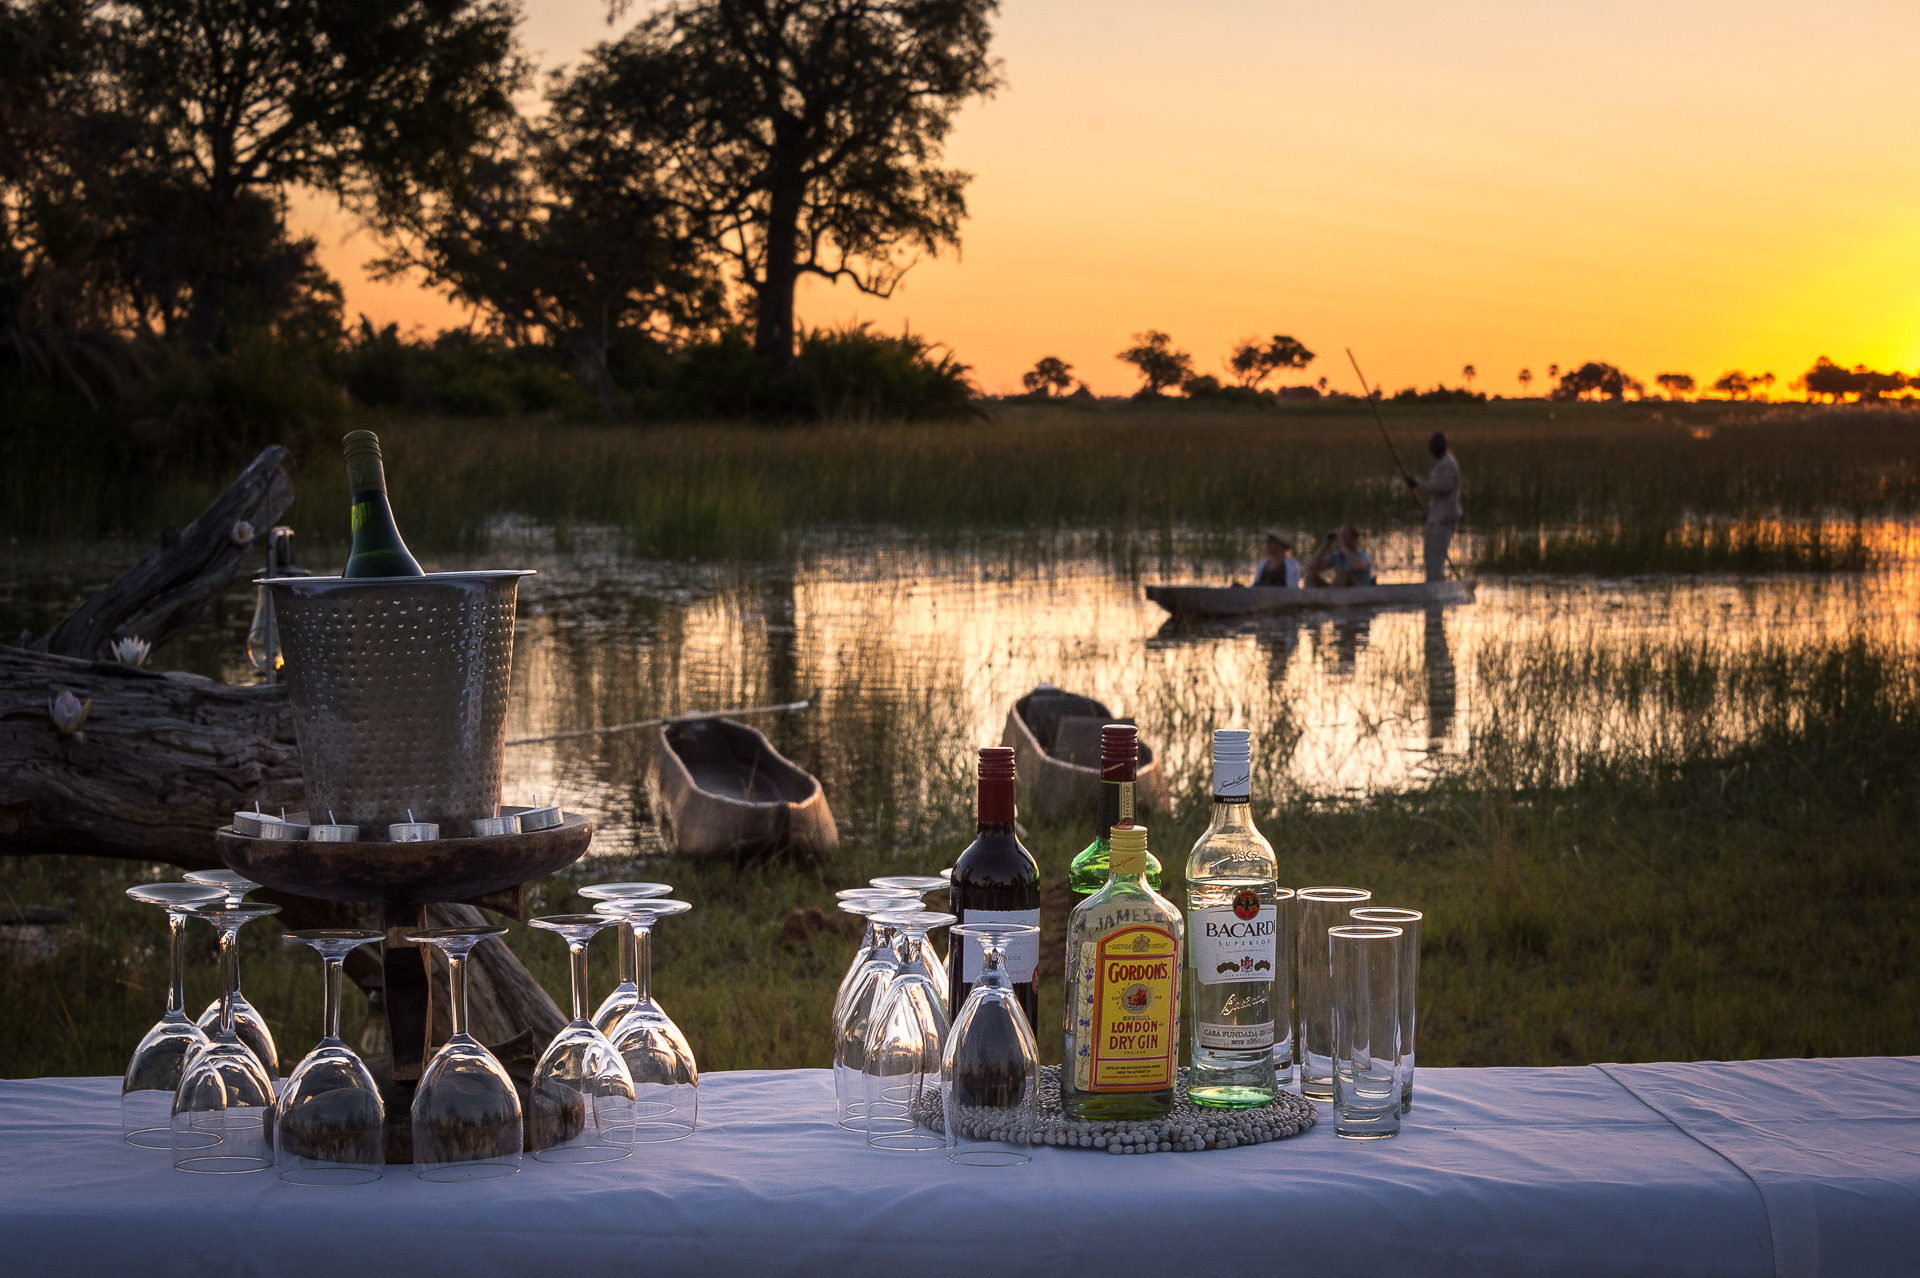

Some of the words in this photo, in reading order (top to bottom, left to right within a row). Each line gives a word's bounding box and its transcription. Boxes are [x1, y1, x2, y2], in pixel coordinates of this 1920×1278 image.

[1231, 850, 1260, 863] 1862
[1108, 962, 1168, 984] GORDON'S
[1111, 1020, 1158, 1034] LONDON
[1204, 1029, 1221, 1037] CASA
[1222, 1030, 1258, 1038] FUNDADA
[1109, 1035, 1136, 1050] DRY
[1137, 1034, 1159, 1049] GIN
